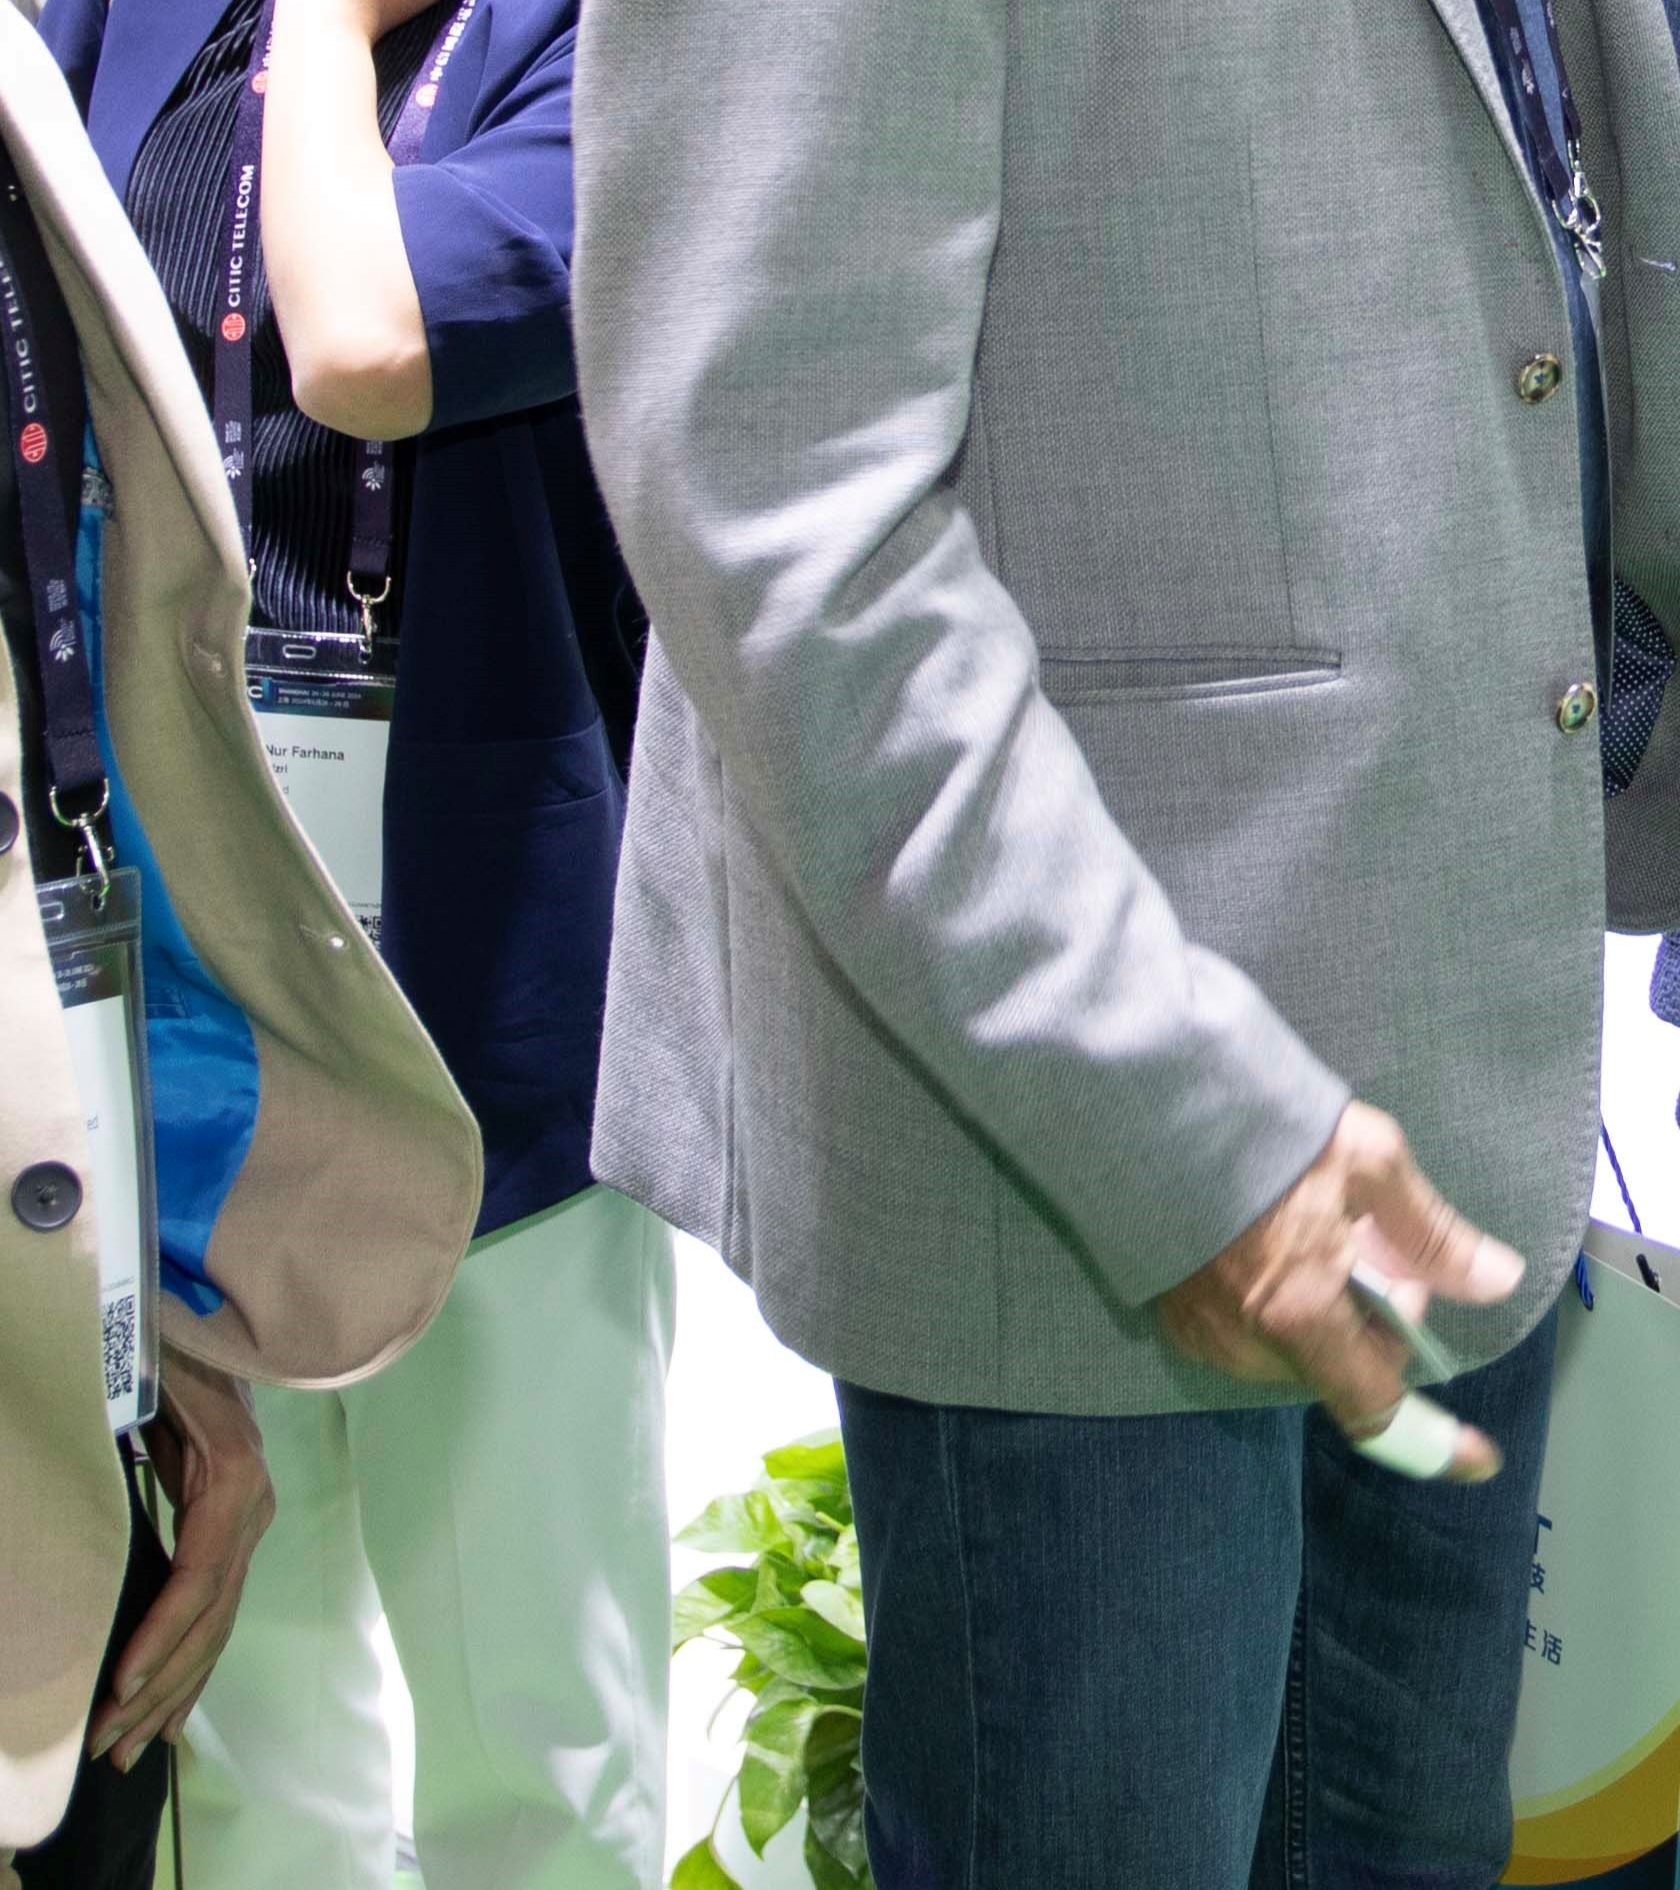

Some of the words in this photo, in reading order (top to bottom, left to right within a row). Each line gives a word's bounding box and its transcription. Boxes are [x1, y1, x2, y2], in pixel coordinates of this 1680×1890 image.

[233, 163, 257, 253] TELECOM
[227, 255, 244, 309] CITIC
[10, 335, 39, 415] CITIC
[291, 745, 346, 761] Farhana
